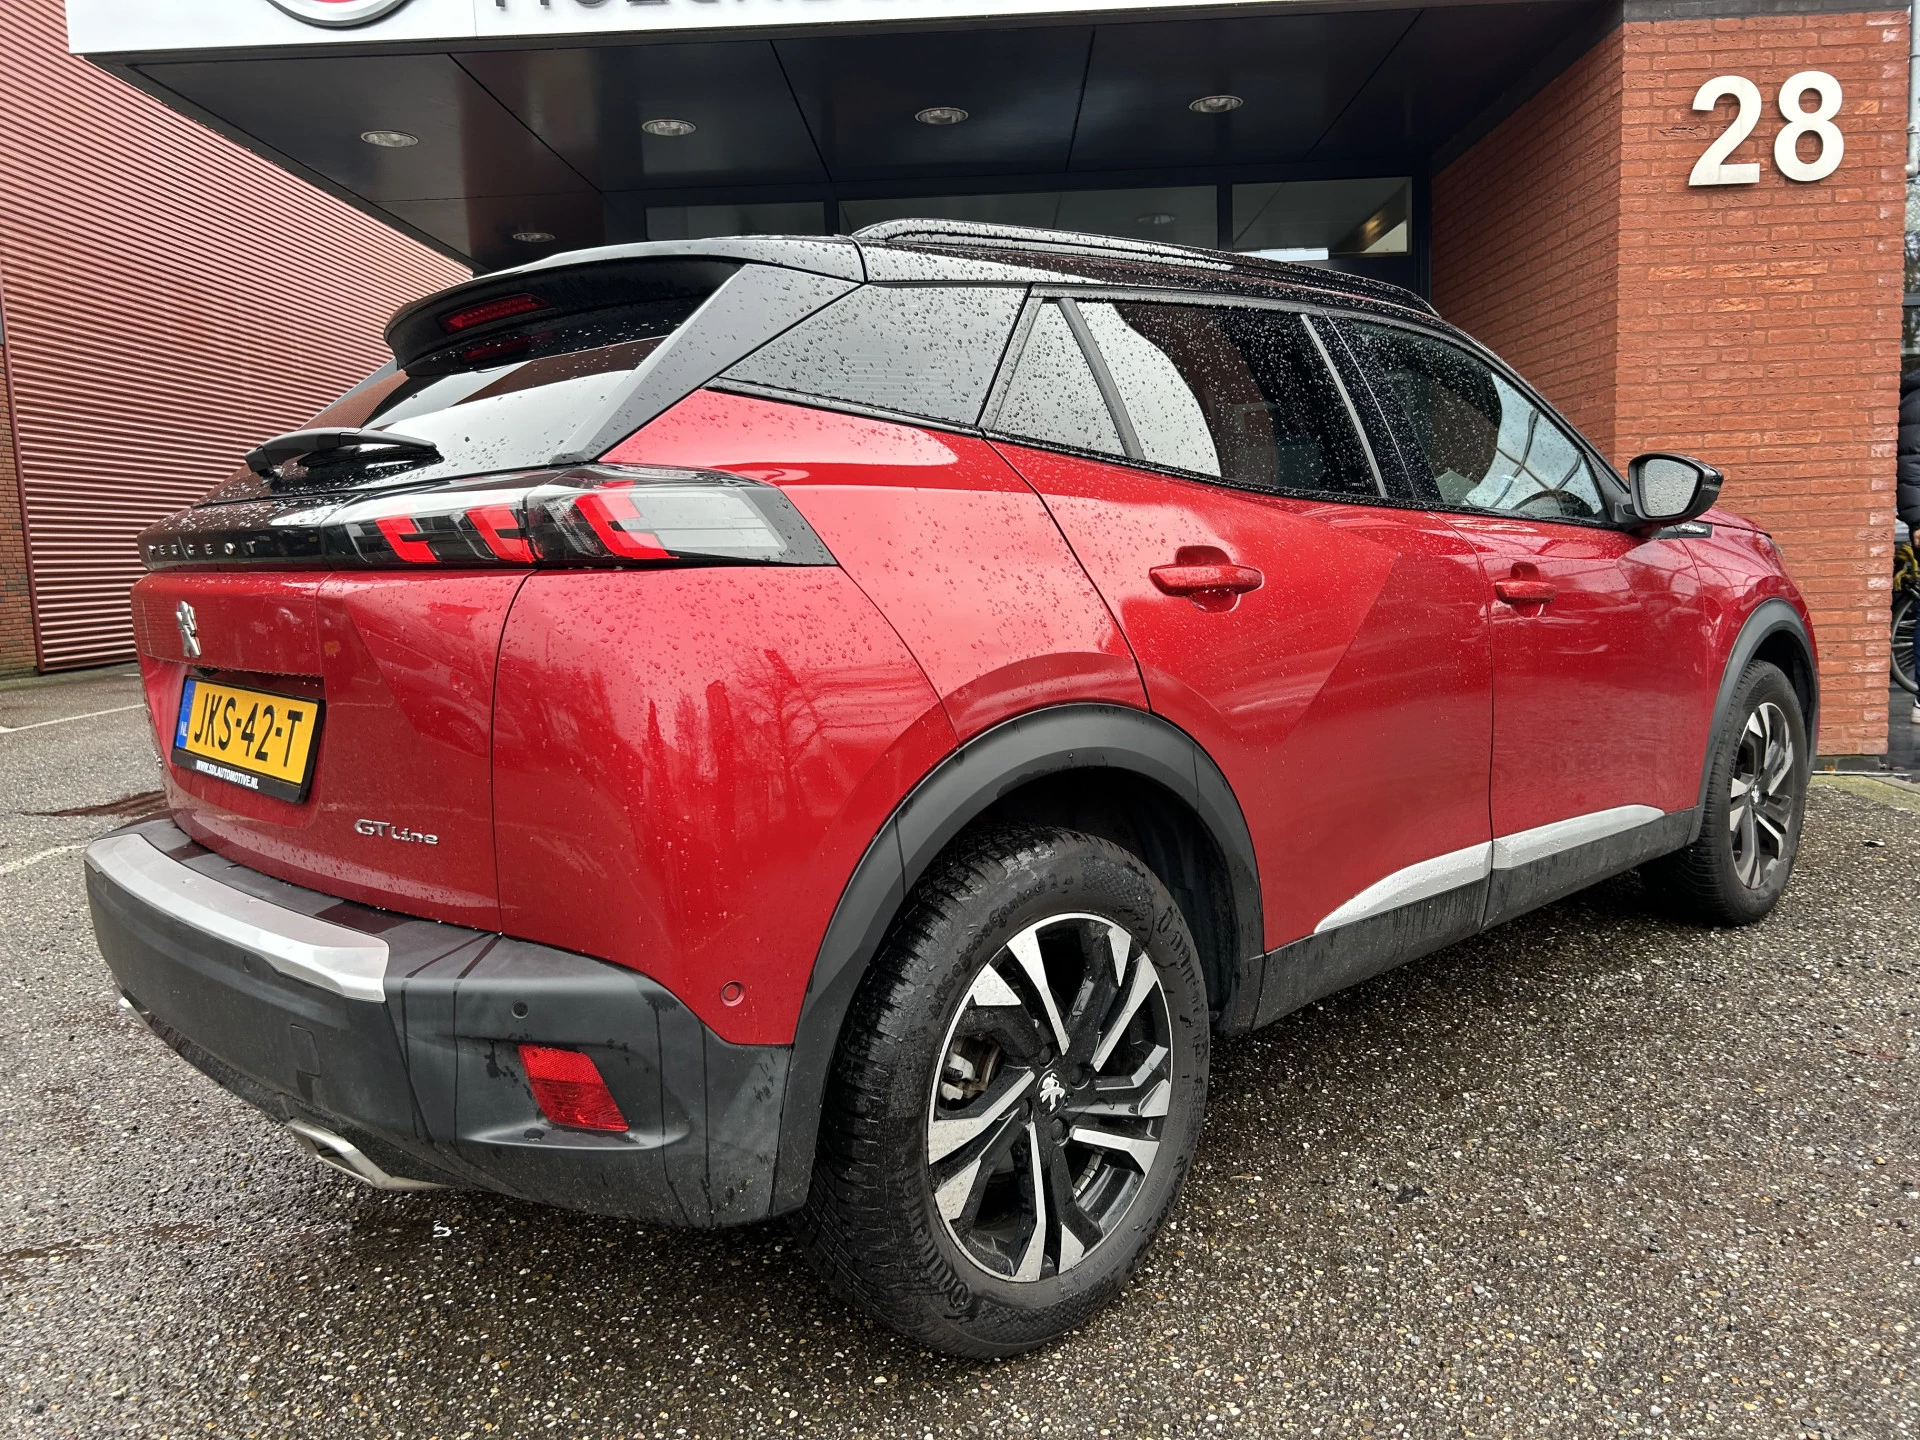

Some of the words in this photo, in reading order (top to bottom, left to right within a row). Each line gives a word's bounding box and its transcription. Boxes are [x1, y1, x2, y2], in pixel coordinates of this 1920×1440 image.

[1688, 71, 1844, 186] 28
[194, 692, 303, 768] JKS-42-T
[354, 818, 390, 837] GT
[391, 826, 440, 845] Line
